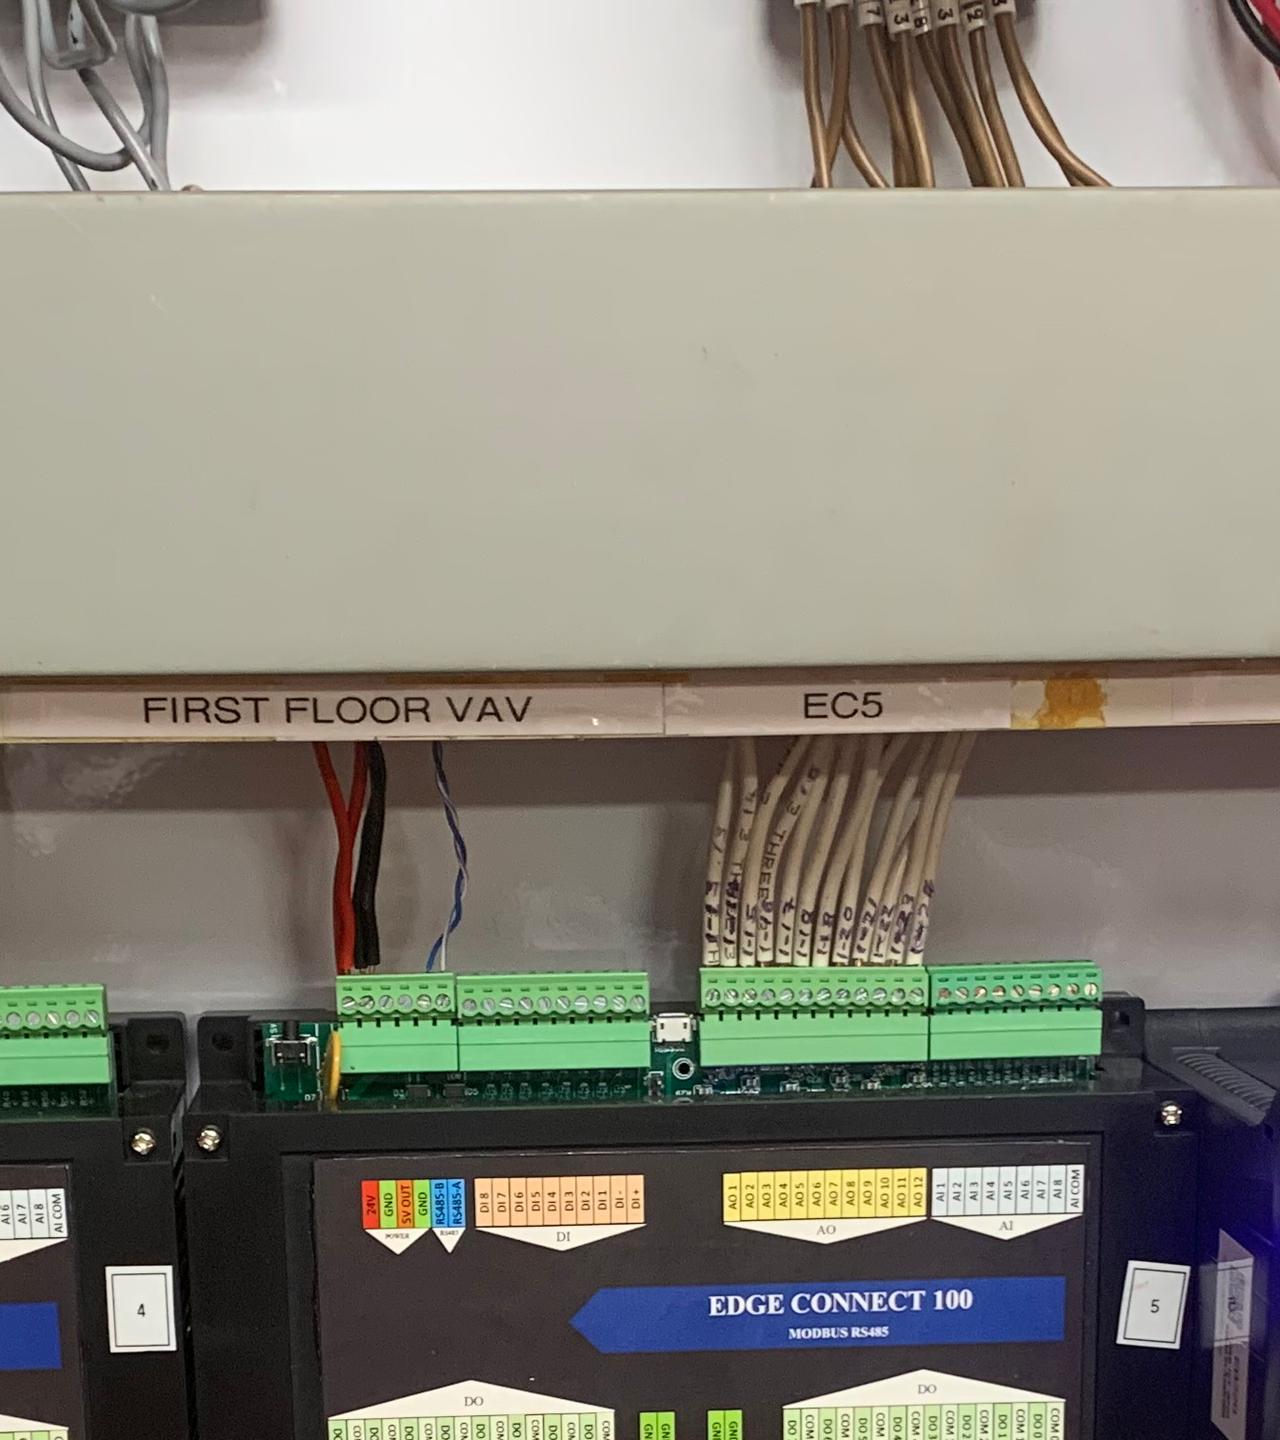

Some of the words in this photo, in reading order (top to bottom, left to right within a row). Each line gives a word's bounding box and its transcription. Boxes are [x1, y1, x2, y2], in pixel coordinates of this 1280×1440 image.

[143, 696, 270, 725] FIRST
[285, 696, 431, 725] FLOOR
[445, 696, 533, 723] VAV
[803, 691, 884, 720] EC5
[1070, 1169, 1080, 1194] COM
[383, 1192, 394, 1217] GND
[418, 1191, 428, 1216] GND
[817, 1225, 836, 1235] AO
[999, 1221, 1013, 1230] AI
[557, 1232, 570, 1242] DI
[709, 1295, 784, 1316] EDGE
[791, 1291, 926, 1313] CONNECT
[934, 1289, 973, 1309] 100
[1151, 1299, 1159, 1313] 5
[137, 1304, 145, 1317] 4
[789, 1327, 848, 1339] MODBUS
[851, 1327, 889, 1337] RS485
[918, 1384, 937, 1394] DO
[464, 1397, 483, 1406] DO
